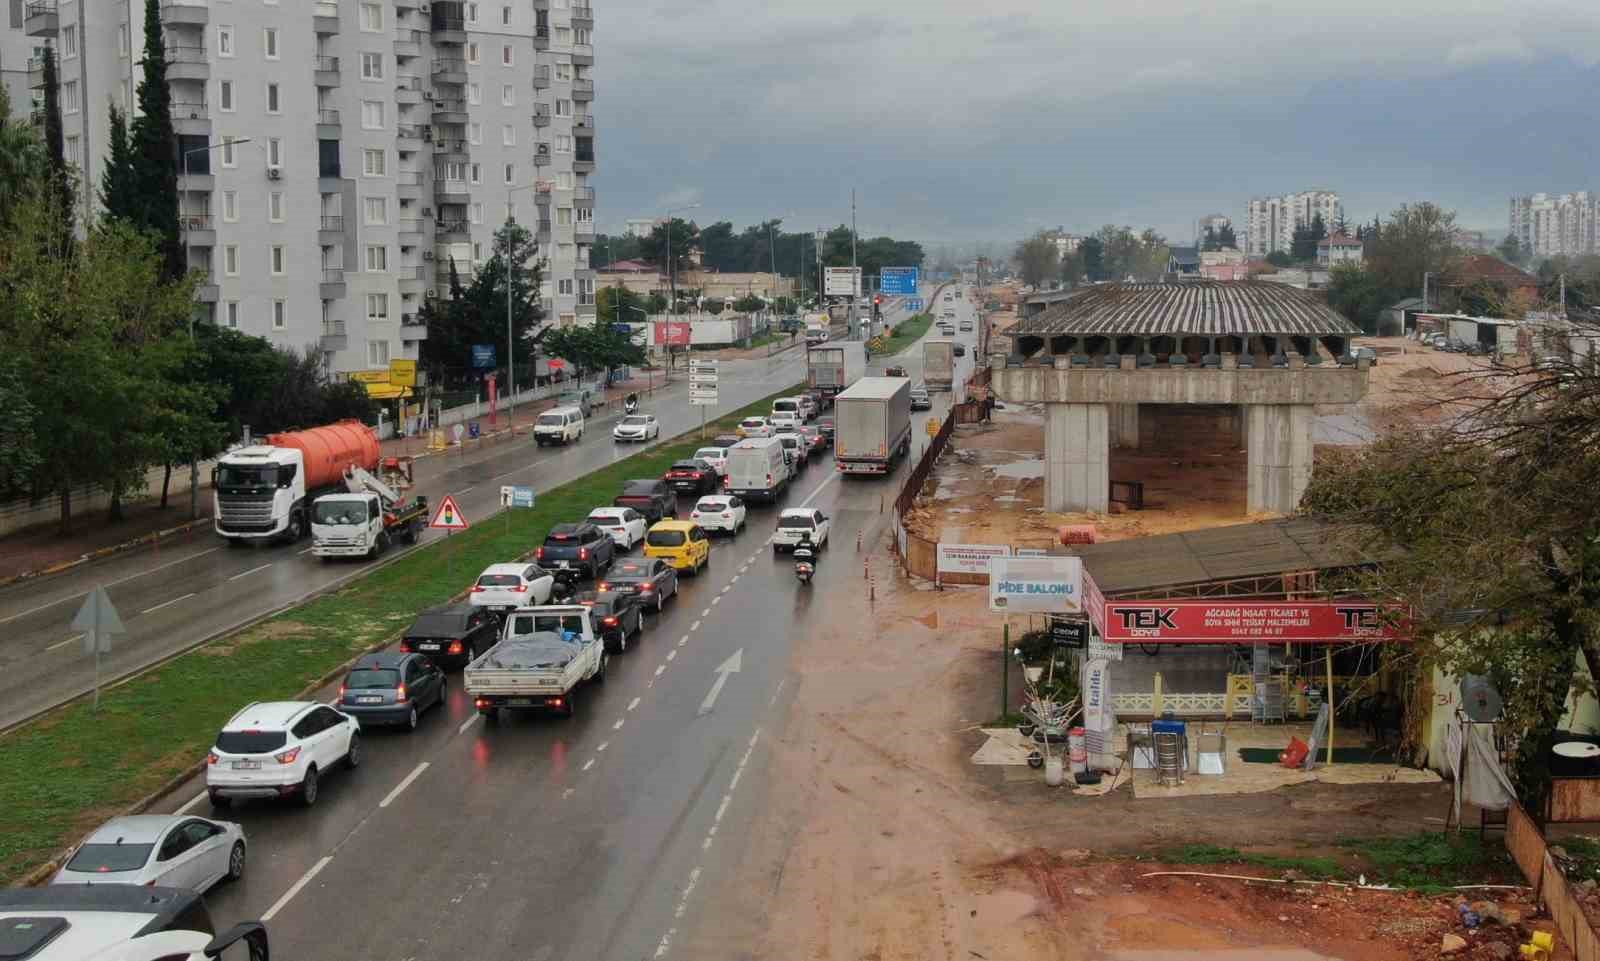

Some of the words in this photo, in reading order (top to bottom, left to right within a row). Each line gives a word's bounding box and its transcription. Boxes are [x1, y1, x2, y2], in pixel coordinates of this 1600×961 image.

[998, 580, 1025, 593] PİDE
[1113, 608, 1178, 629] TEK
[1269, 607, 1298, 617] TİCARET
